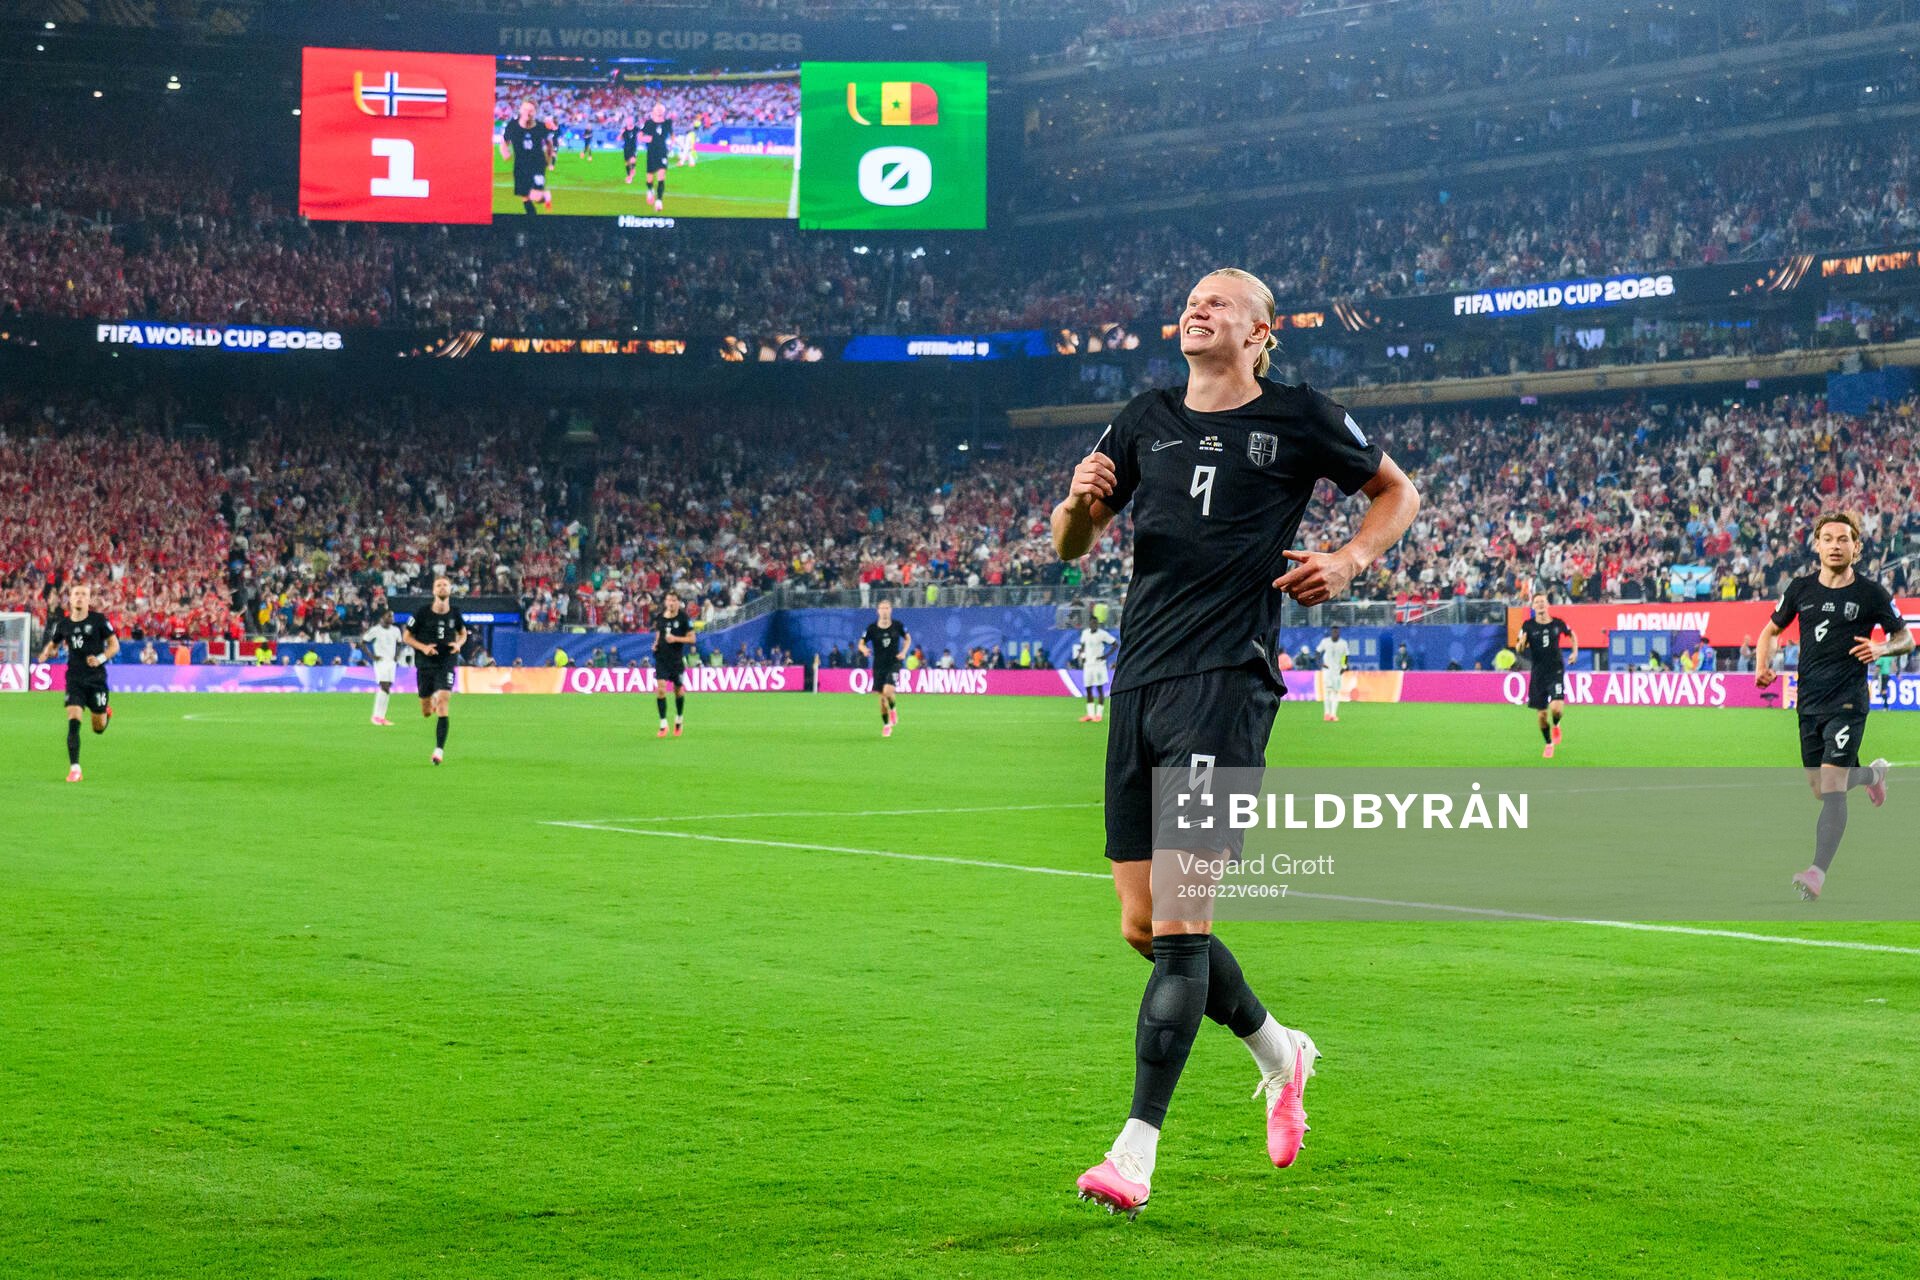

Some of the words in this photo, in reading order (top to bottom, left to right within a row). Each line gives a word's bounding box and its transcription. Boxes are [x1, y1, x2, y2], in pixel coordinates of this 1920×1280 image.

[500, 28, 552, 47] FIFA
[559, 28, 650, 49] WORLD
[658, 31, 710, 49] CUP
[713, 32, 803, 51] 2026
[370, 138, 429, 198] 1
[858, 146, 932, 206] 0
[1453, 293, 1495, 316] FIFA
[1495, 286, 1562, 312] WORLD
[1564, 282, 1603, 305] CUP
[1604, 275, 1674, 302] 2026
[97, 324, 144, 344] FIFA
[145, 326, 222, 347] WORLD
[223, 329, 267, 348] CUP
[268, 331, 342, 350] 2026
[1189, 465, 1217, 516] 9
[1616, 611, 1710, 637] NORWAY
[1814, 618, 1831, 642] 6
[71, 635, 84, 649] 16
[682, 665, 786, 691] AIRWAYS
[916, 668, 988, 694] AIRWAYS
[1503, 671, 1594, 705] QAR
[1603, 671, 1727, 706] AIRWAYS
[96, 692, 107, 706] 16
[1834, 725, 1850, 750] 6
[1188, 753, 1216, 806] 9
